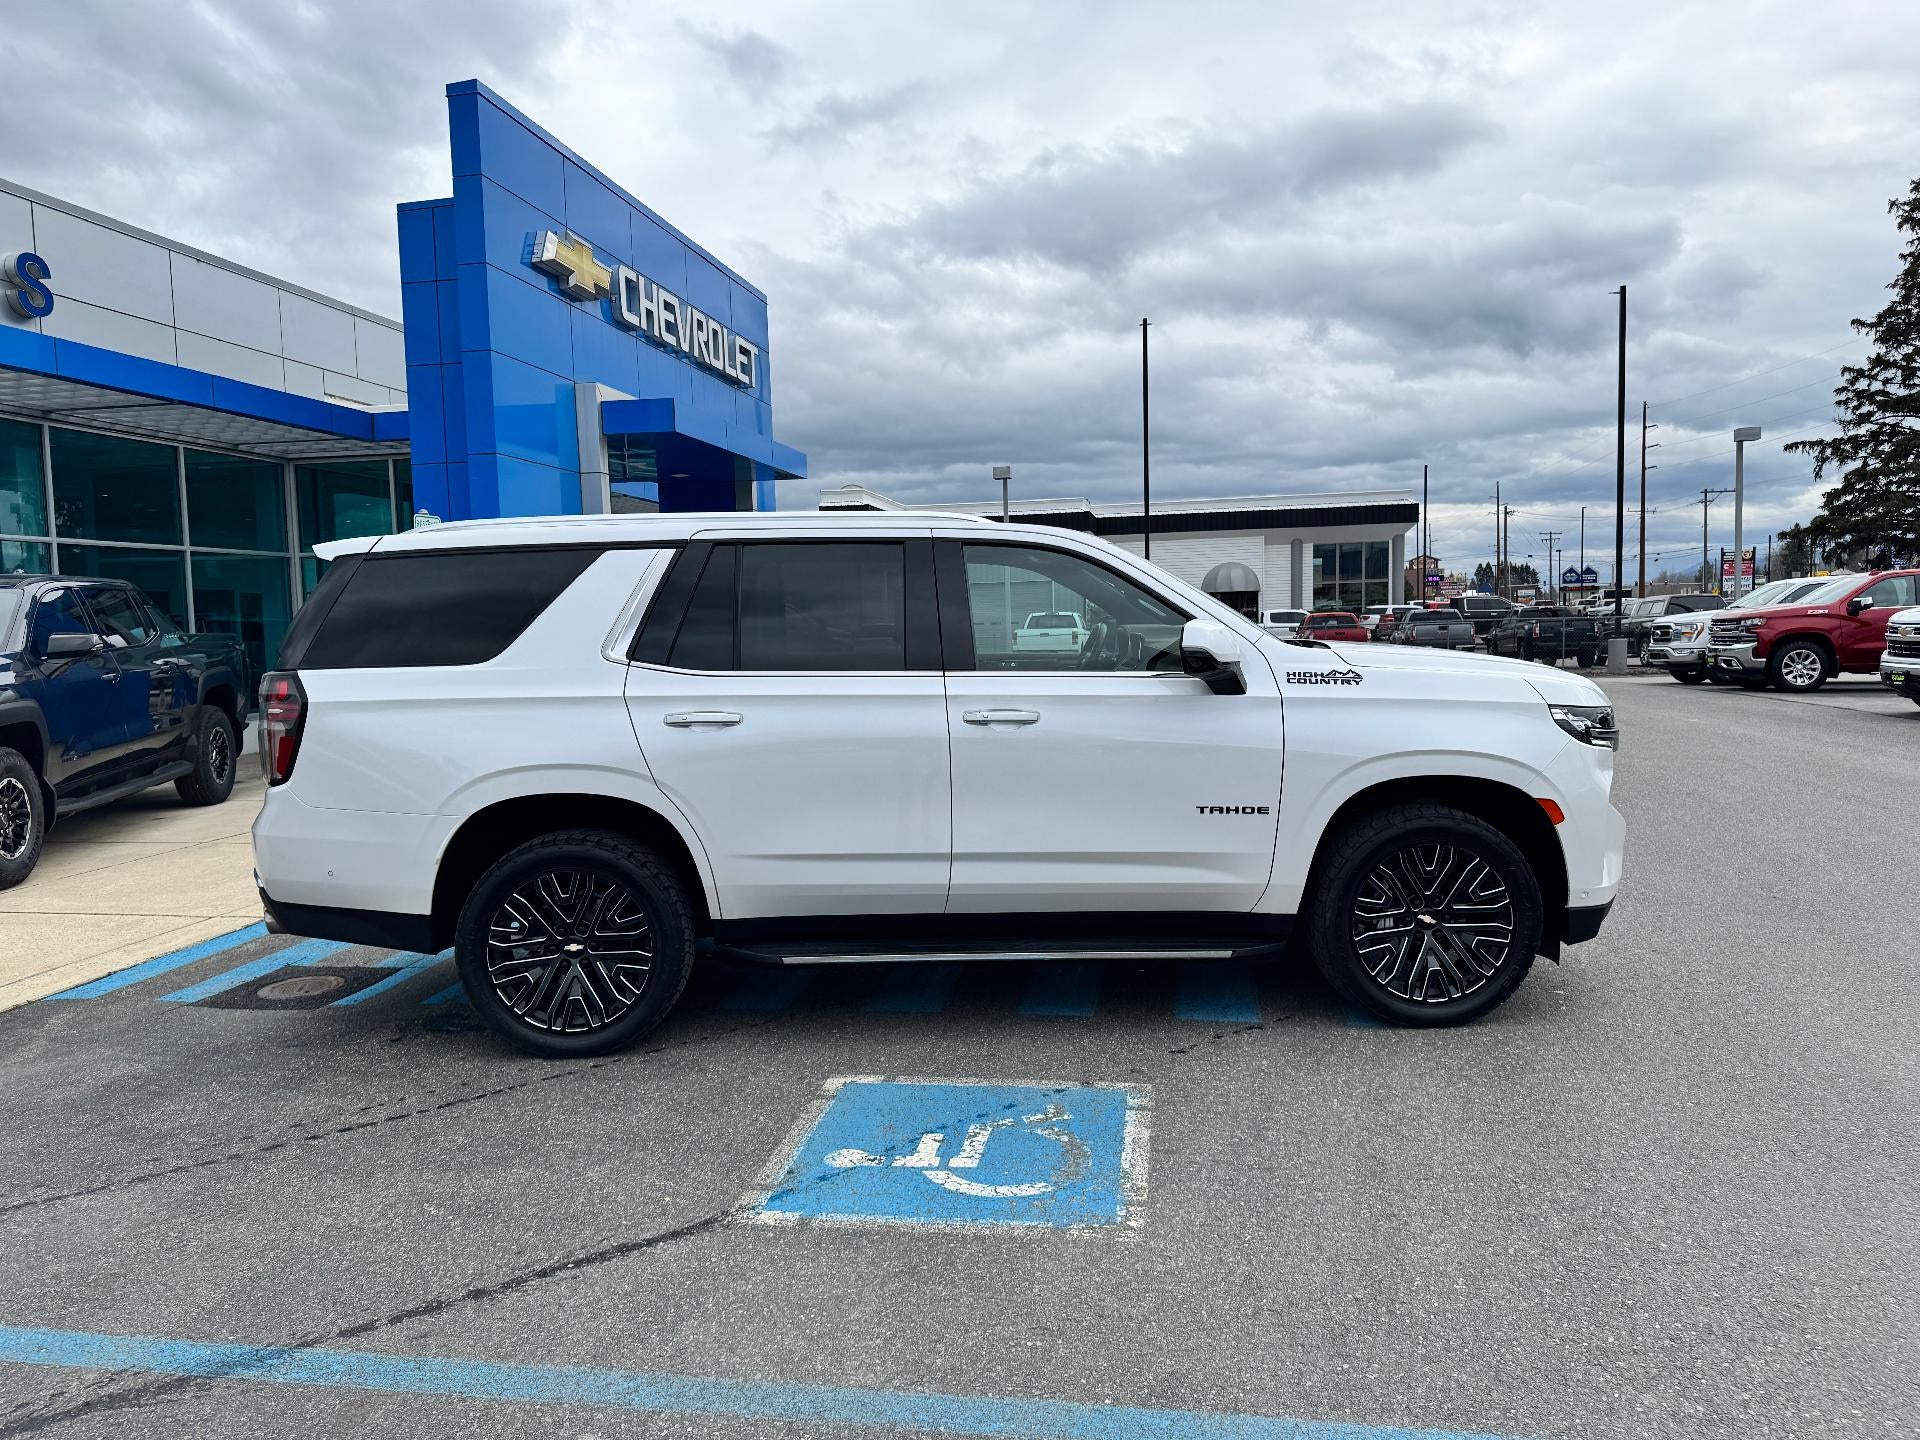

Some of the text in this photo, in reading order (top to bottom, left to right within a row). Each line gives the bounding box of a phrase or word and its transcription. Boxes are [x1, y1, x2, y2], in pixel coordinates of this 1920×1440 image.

[616, 264, 759, 388] CHEVROLET
[1286, 671, 1326, 679] HIGH
[1286, 678, 1364, 686] COUNTRY
[1195, 805, 1270, 815] TAHOE
